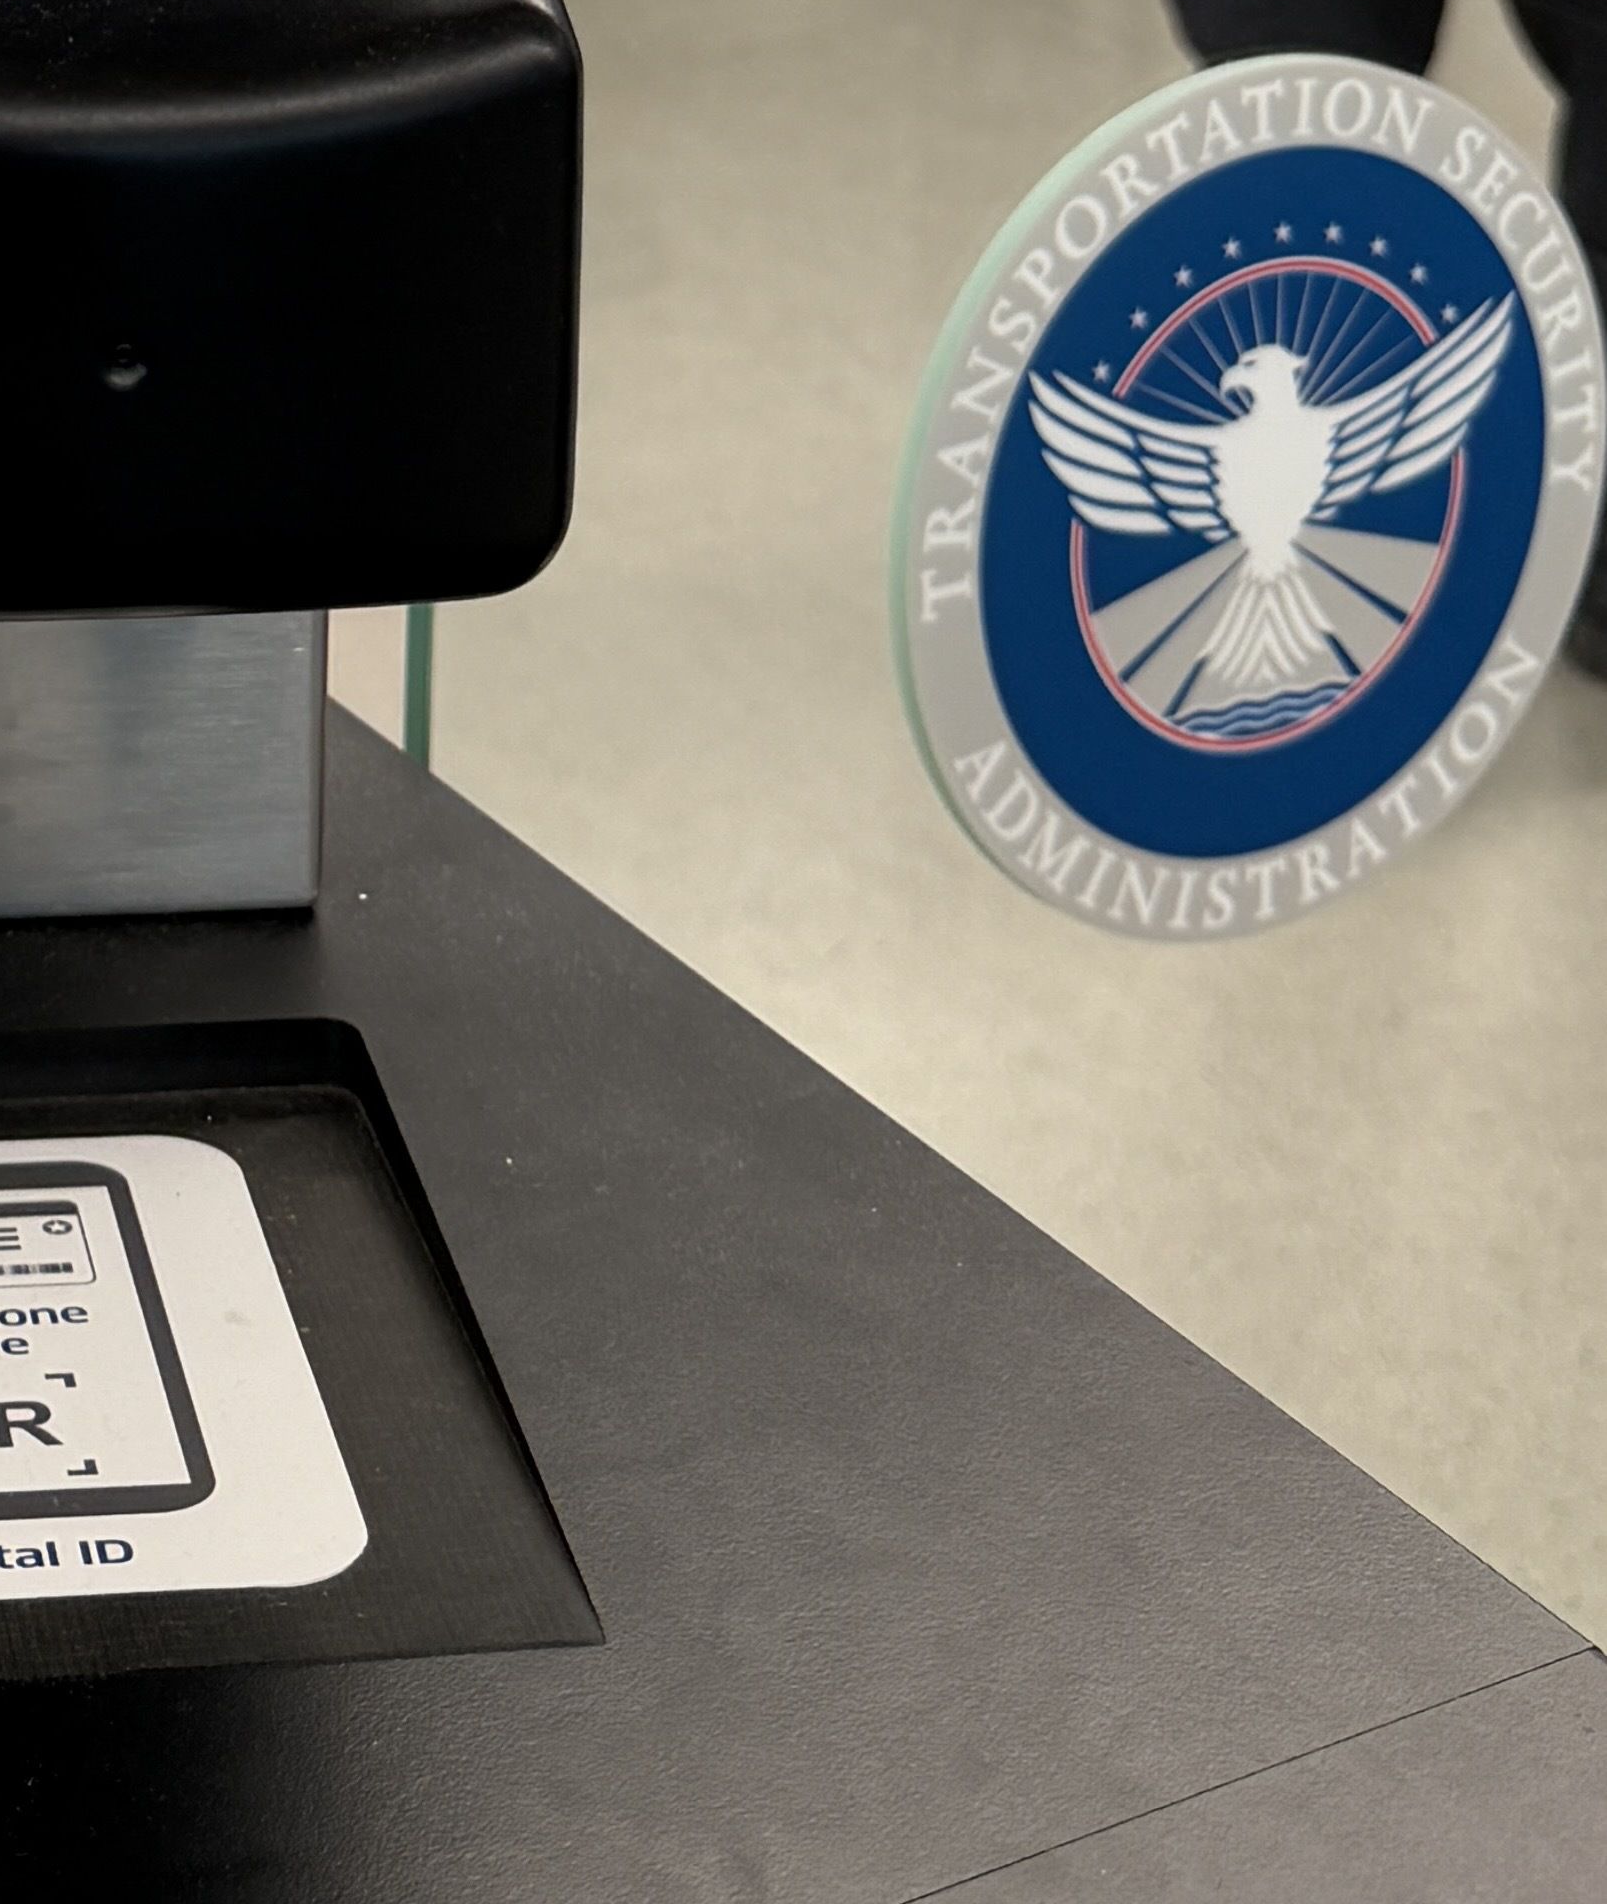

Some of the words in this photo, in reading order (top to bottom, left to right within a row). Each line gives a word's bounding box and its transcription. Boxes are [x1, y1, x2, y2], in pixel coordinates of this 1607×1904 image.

[920, 76, 1436, 623] TRANSPORTATION
[1438, 125, 1596, 492] SECURITY
[952, 638, 1541, 933] ADMINISTRATION
[78, 1539, 134, 1565] ID
